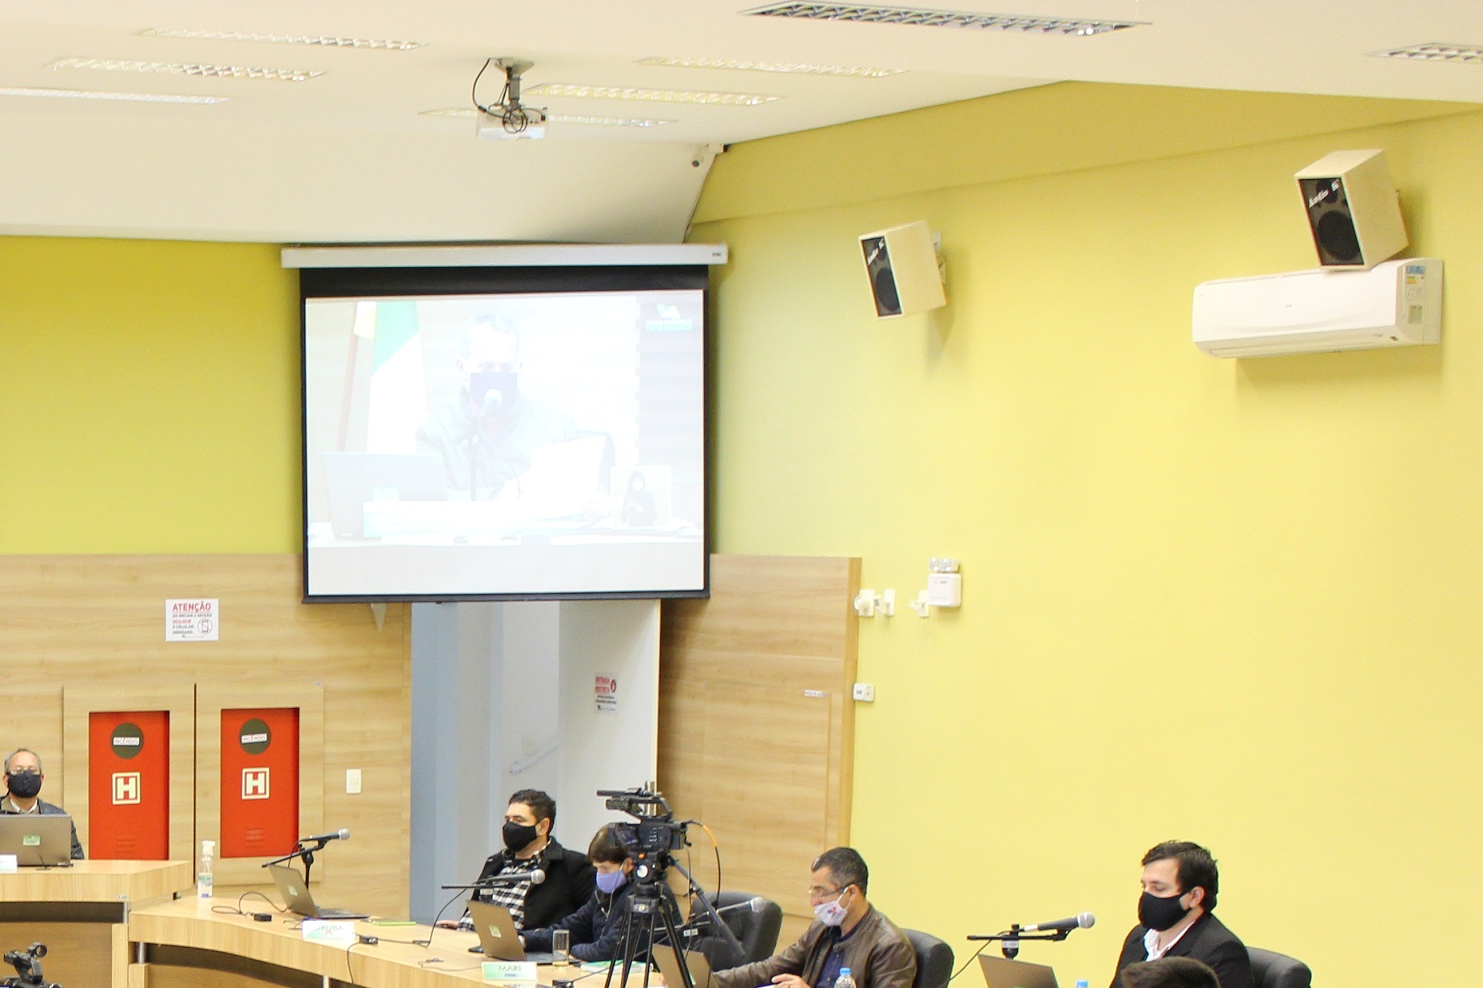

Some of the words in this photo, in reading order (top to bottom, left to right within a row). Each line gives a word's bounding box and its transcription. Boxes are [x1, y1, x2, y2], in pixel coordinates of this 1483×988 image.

[173, 601, 211, 612] ATENÇÃO
[117, 777, 136, 799] H
[246, 773, 264, 794] H
